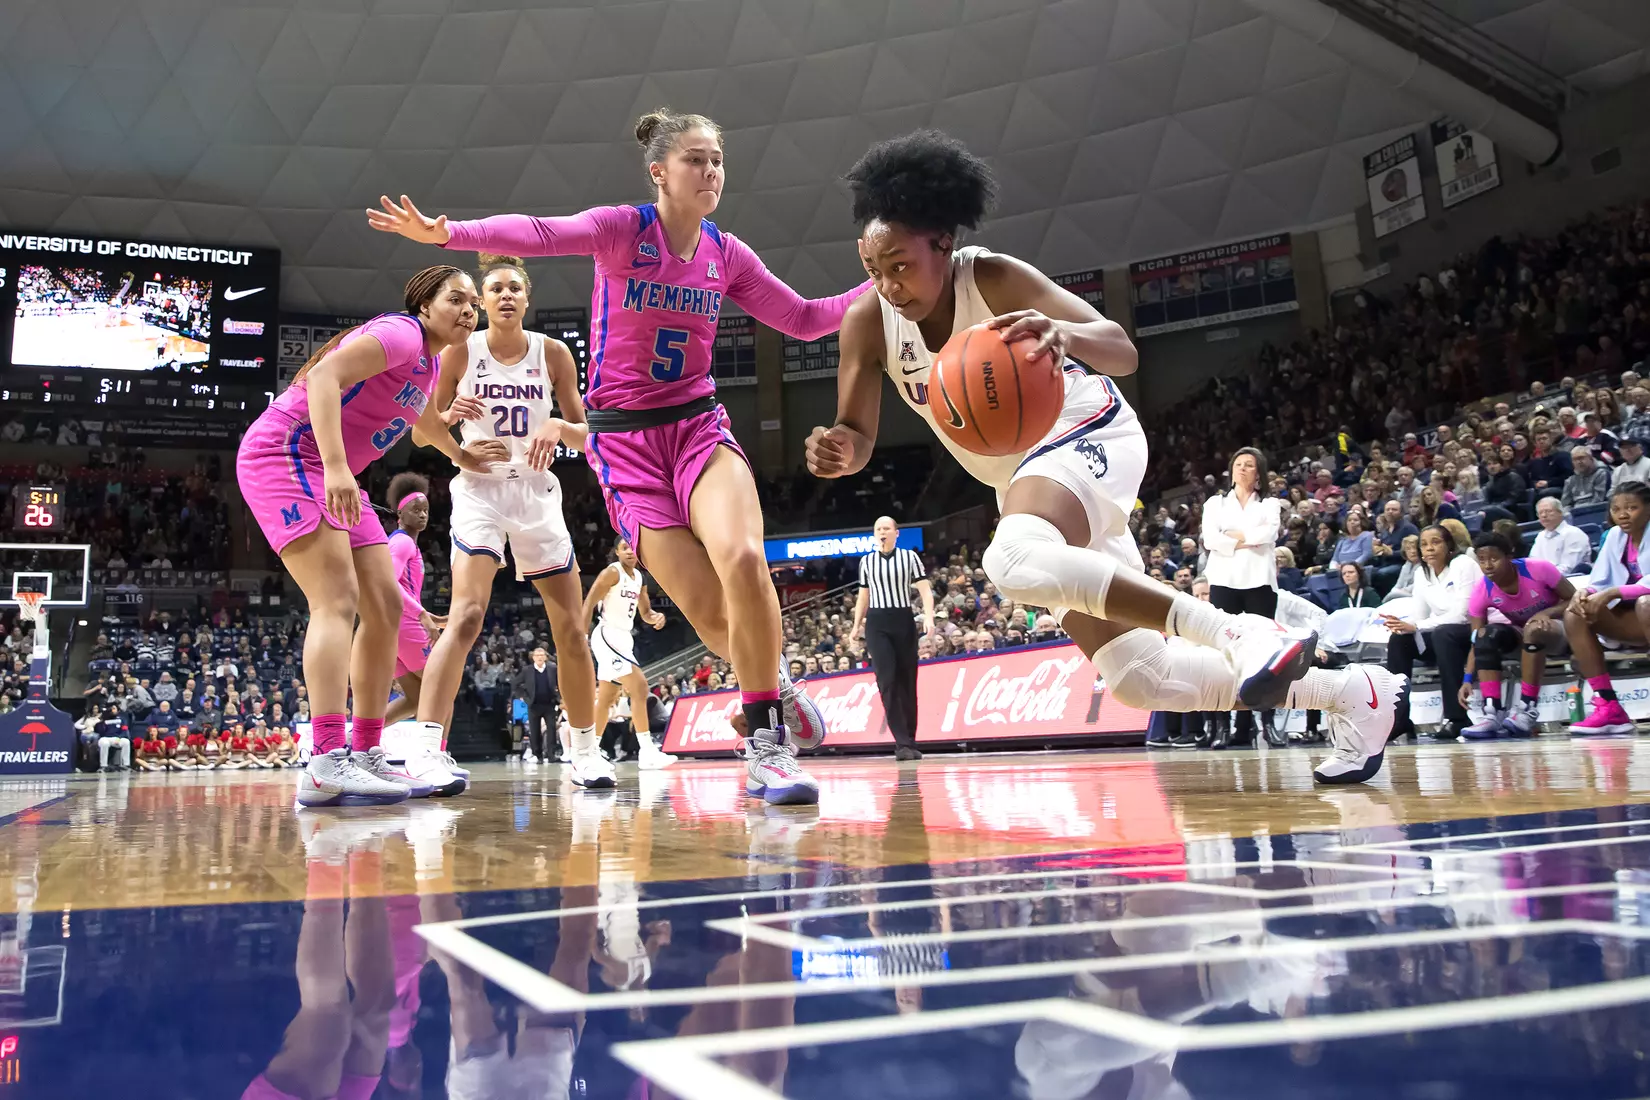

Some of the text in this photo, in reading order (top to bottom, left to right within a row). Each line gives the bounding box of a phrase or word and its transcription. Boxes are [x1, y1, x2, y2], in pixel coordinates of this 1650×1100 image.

[0, 235, 253, 266] NIVERSITY OF CONNECTICUT
[1138, 237, 1281, 272] NCAA CHAMPIONSHIP
[622, 277, 721, 324] MEMPHIS
[283, 341, 305, 356] 52
[649, 326, 690, 383] 5
[219, 358, 258, 368] TRAVELERS
[100, 378, 131, 393] 5:11
[475, 383, 543, 400] UCONN
[902, 381, 930, 406] U
[982, 361, 1000, 411] UCONN
[2, 390, 9, 400] 3
[43, 392, 51, 402] 3
[207, 399, 215, 409] 3
[491, 405, 529, 438] 20
[371, 416, 412, 451] 3
[30, 491, 59, 504] 5:11
[24, 504, 53, 527] 26
[279, 501, 303, 528] M
[124, 594, 143, 604] 116
[627, 602, 636, 619] 5
[0, 751, 68, 763] TRAVELERS
